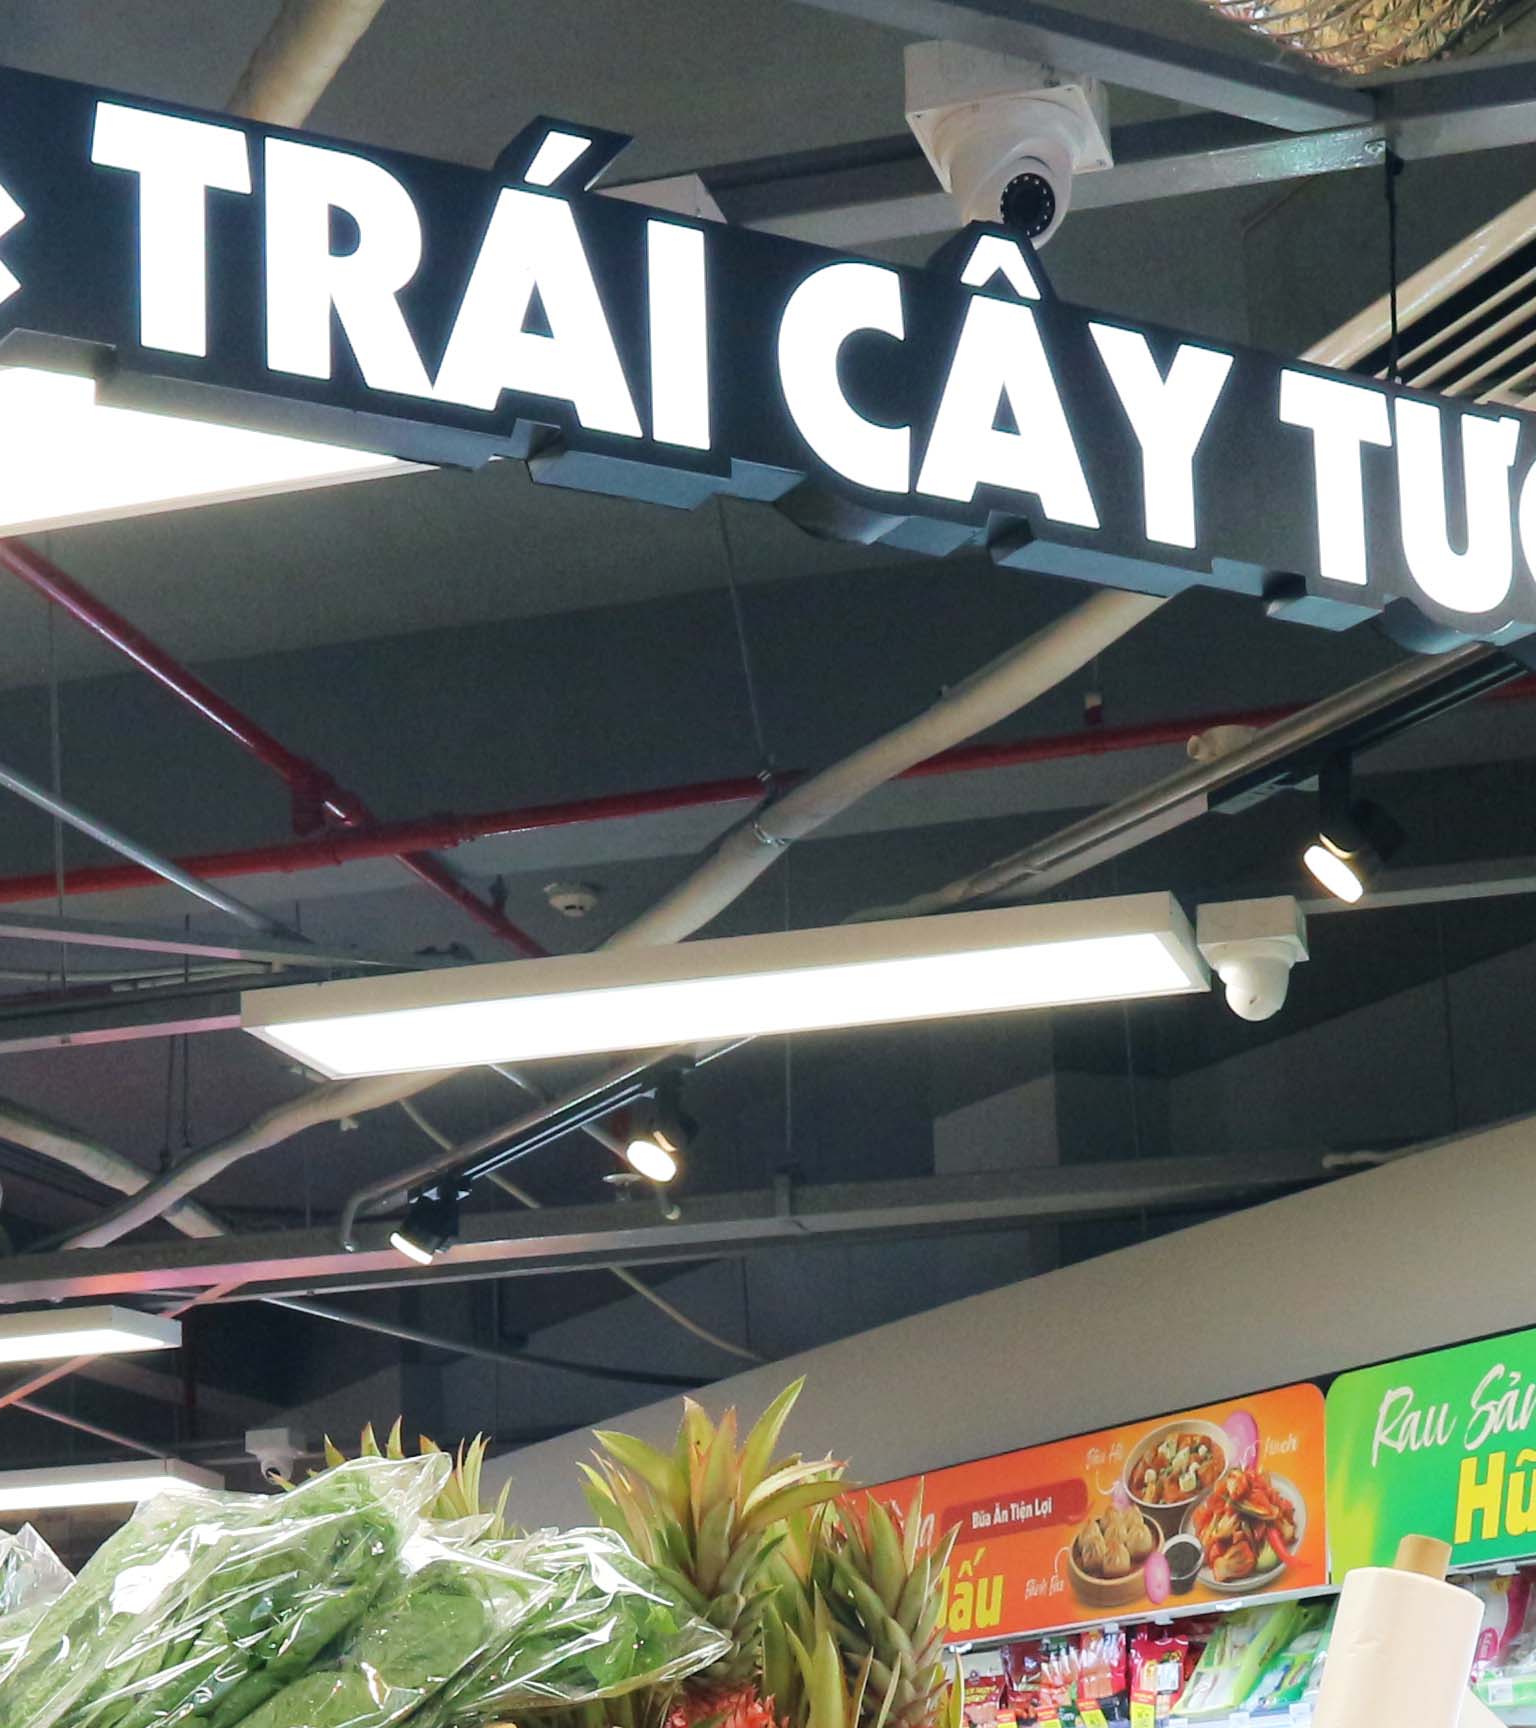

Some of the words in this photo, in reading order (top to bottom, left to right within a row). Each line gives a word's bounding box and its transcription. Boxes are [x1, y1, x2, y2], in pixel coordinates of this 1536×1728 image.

[90, 100, 711, 452] TRÁI
[777, 232, 1235, 549] CÂY
[1369, 1386, 1458, 1467] Rau
[1035, 1497, 1052, 1518] Lợi
